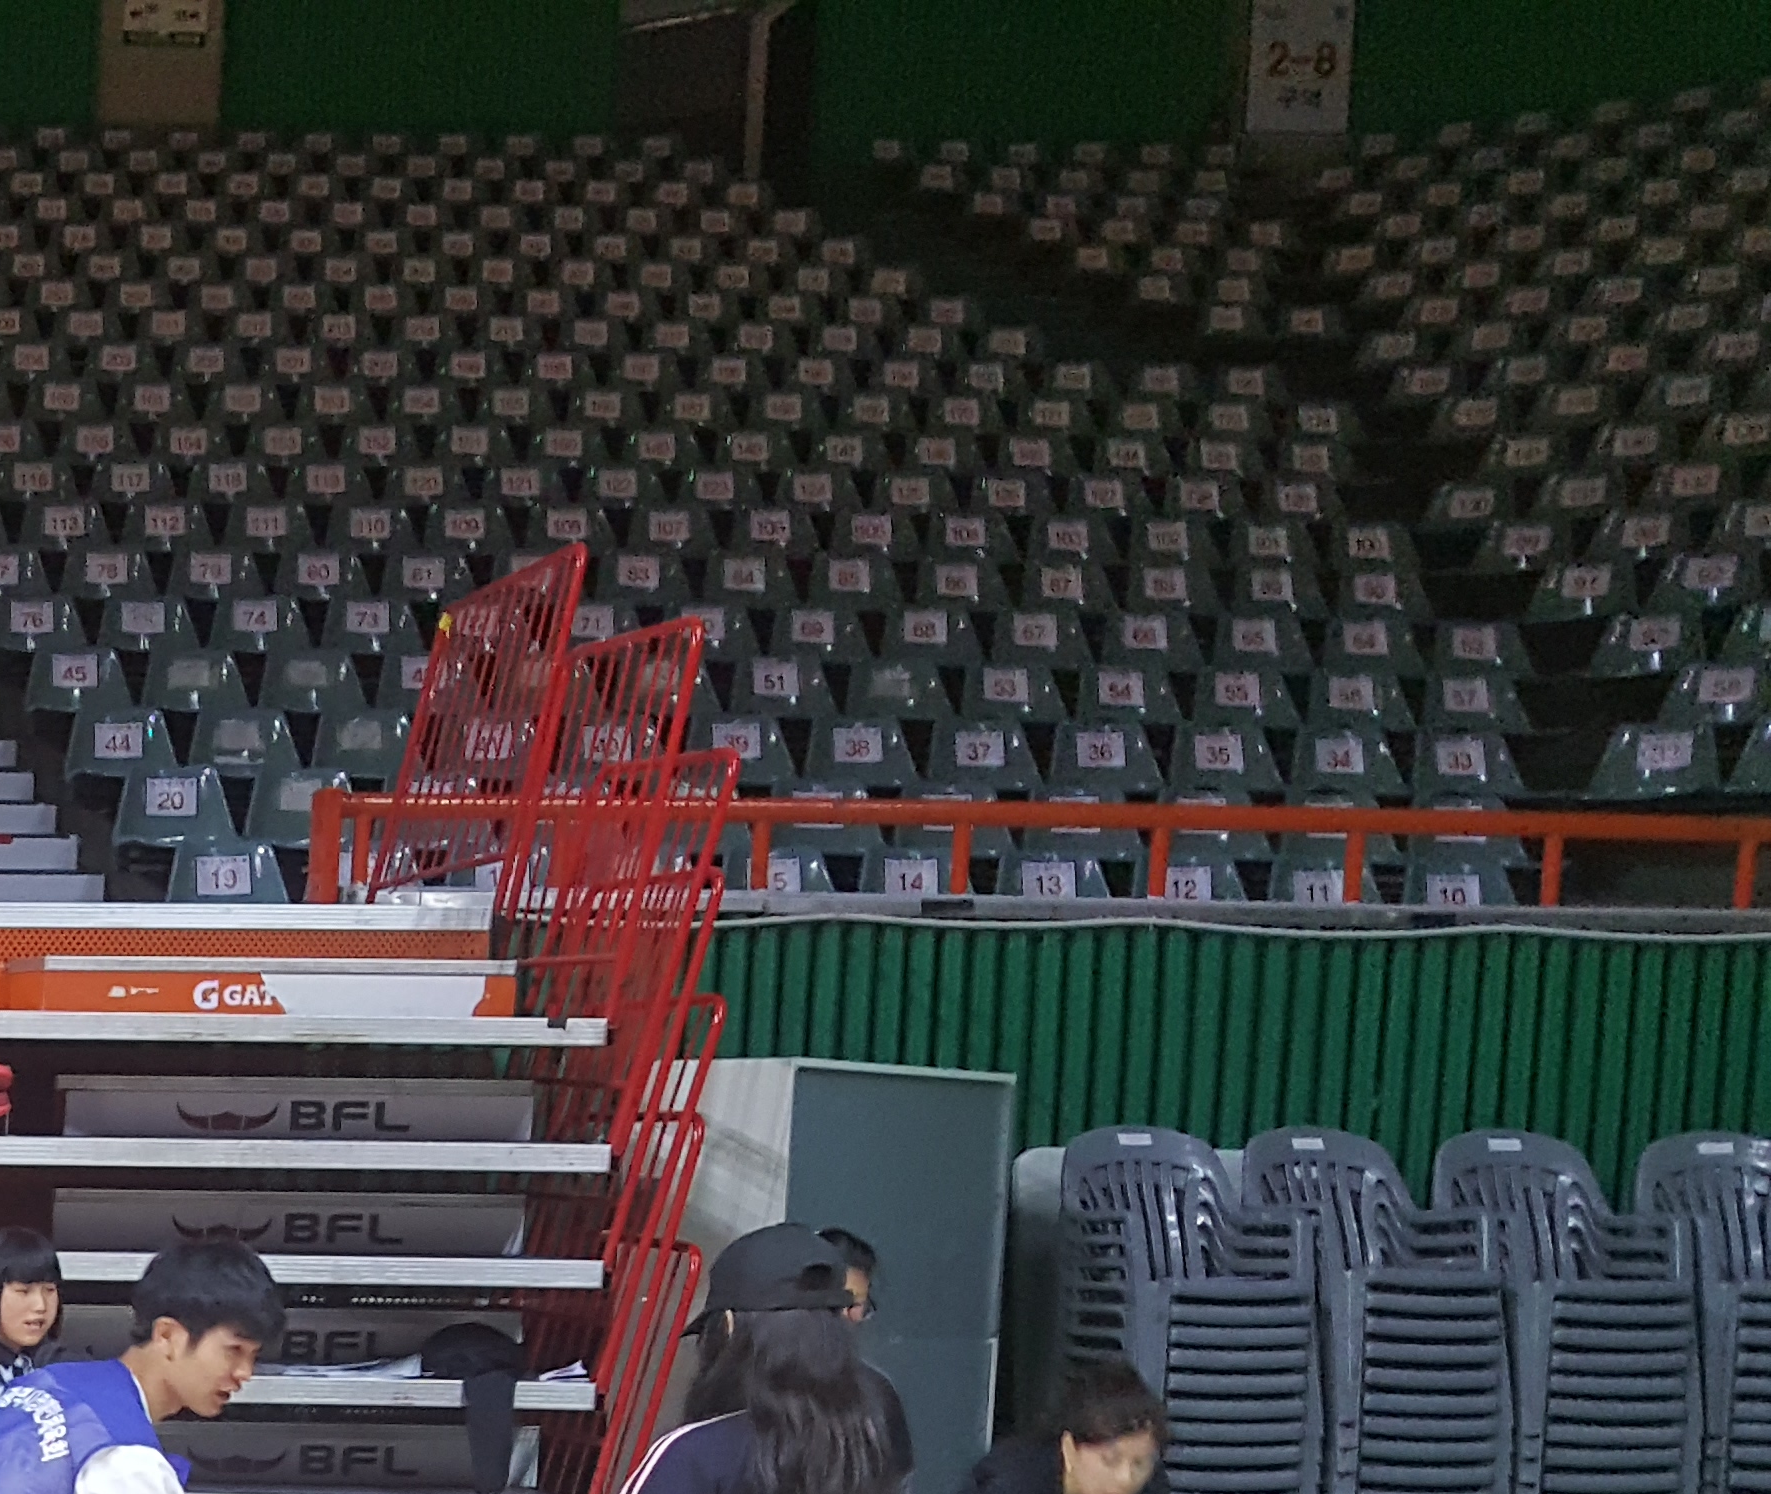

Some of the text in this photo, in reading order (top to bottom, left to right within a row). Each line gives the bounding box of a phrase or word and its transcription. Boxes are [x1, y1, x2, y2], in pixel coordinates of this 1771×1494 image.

[1266, 41, 1337, 78] 2-8
[105, 734, 131, 752] 44
[157, 792, 184, 810] 20
[212, 869, 237, 889] 19
[900, 873, 922, 891] 14
[1036, 875, 1061, 895] 13
[1173, 880, 1196, 900] 12
[290, 1101, 410, 1132] BFL
[283, 1213, 403, 1244] BFL
[299, 1444, 419, 1476] BFL
